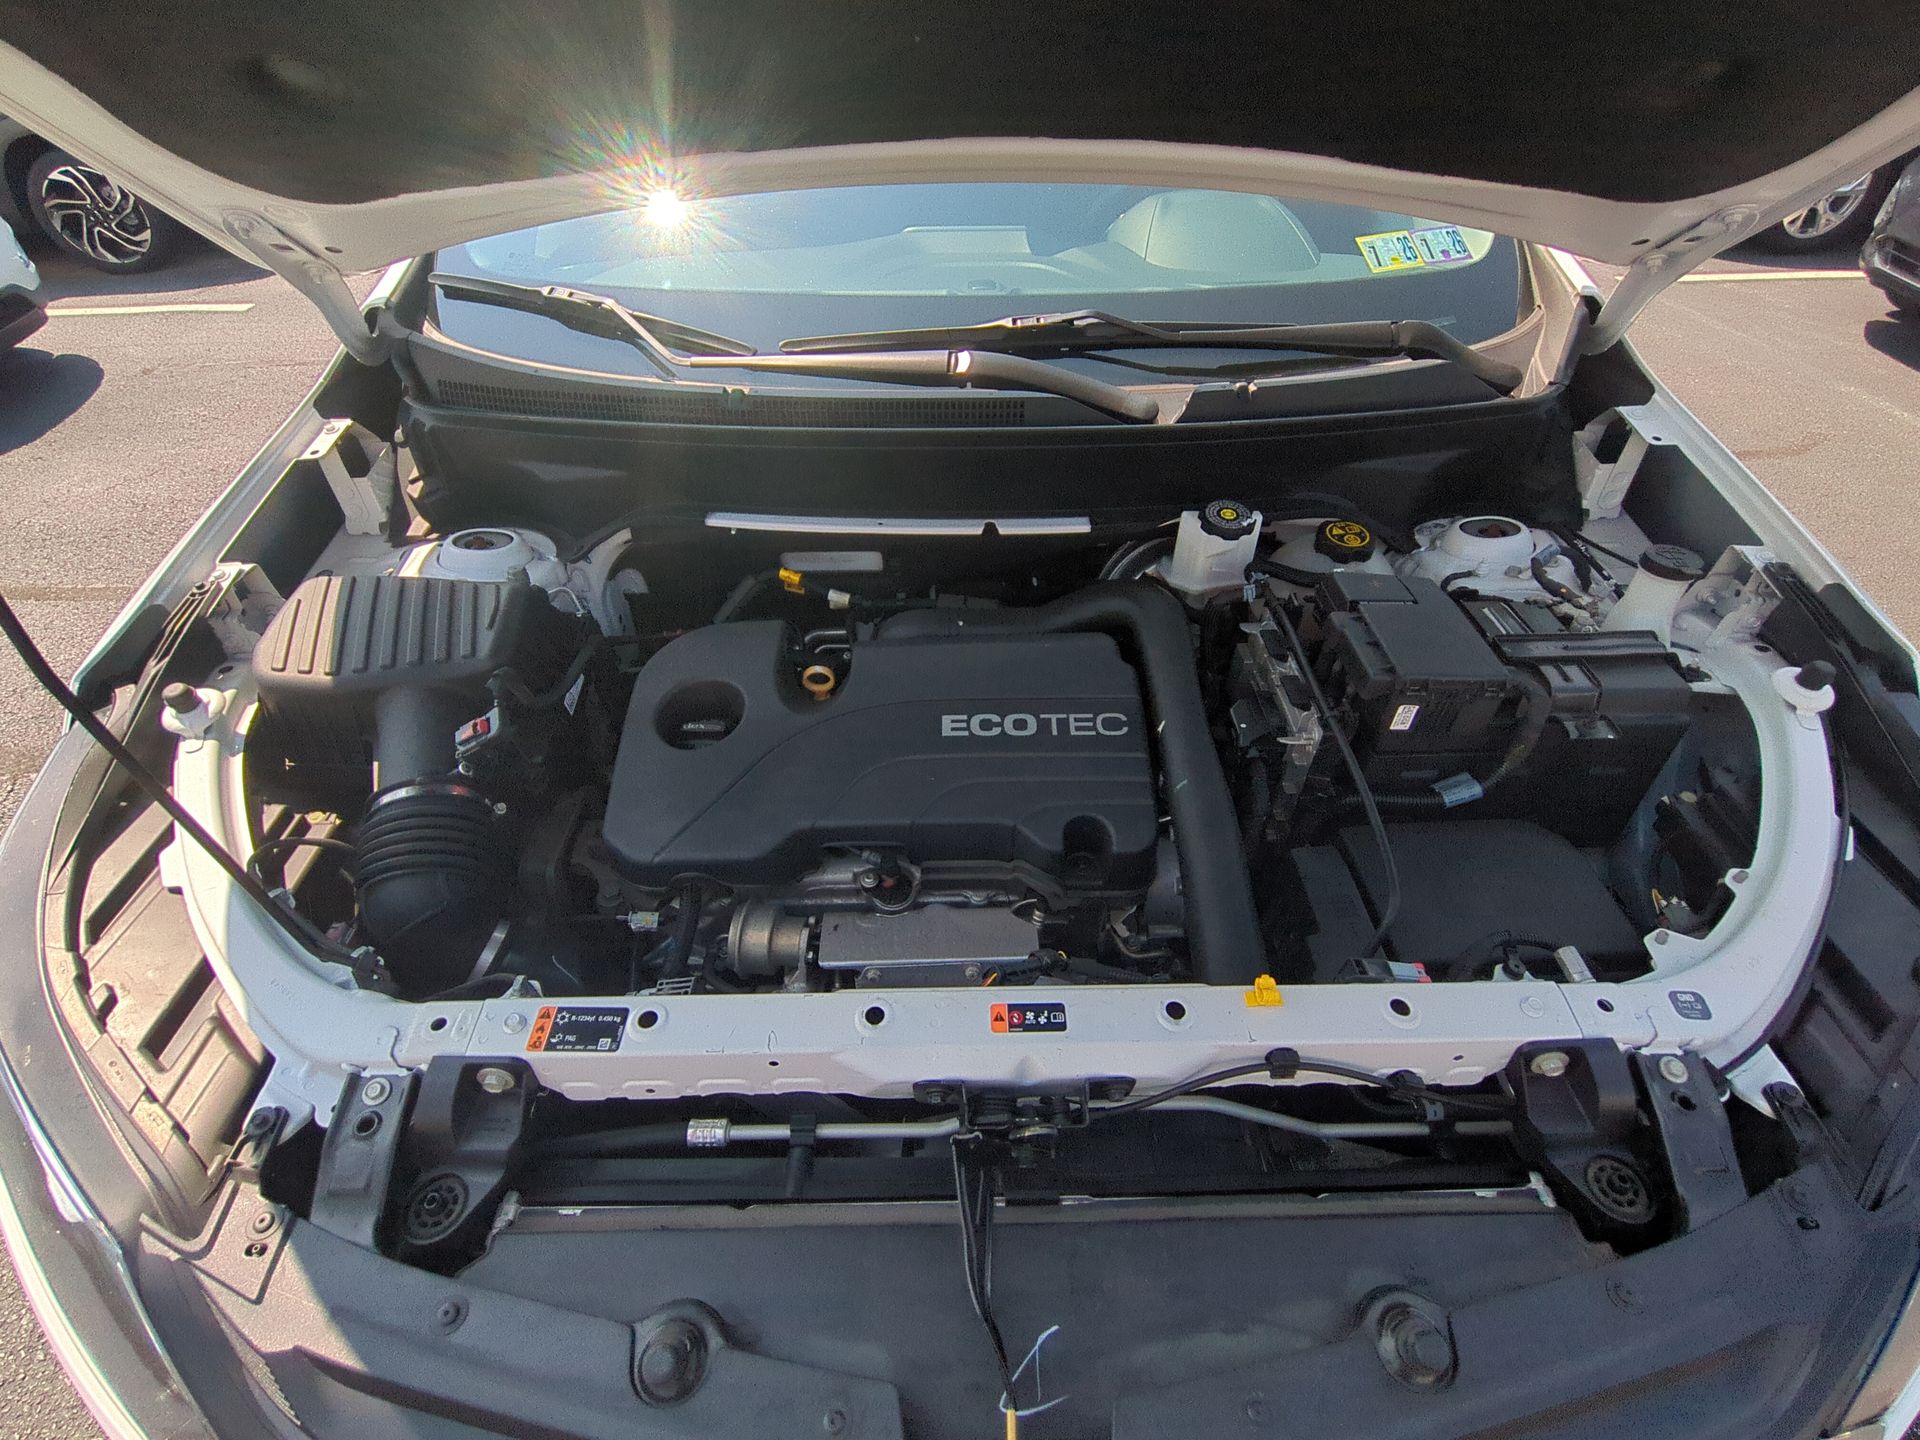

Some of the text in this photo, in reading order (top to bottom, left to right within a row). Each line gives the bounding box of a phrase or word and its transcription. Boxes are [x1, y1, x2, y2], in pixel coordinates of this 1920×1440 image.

[1397, 236, 1418, 260] 26
[1447, 231, 1467, 254] 26
[941, 713, 1129, 736] ECOTEC
